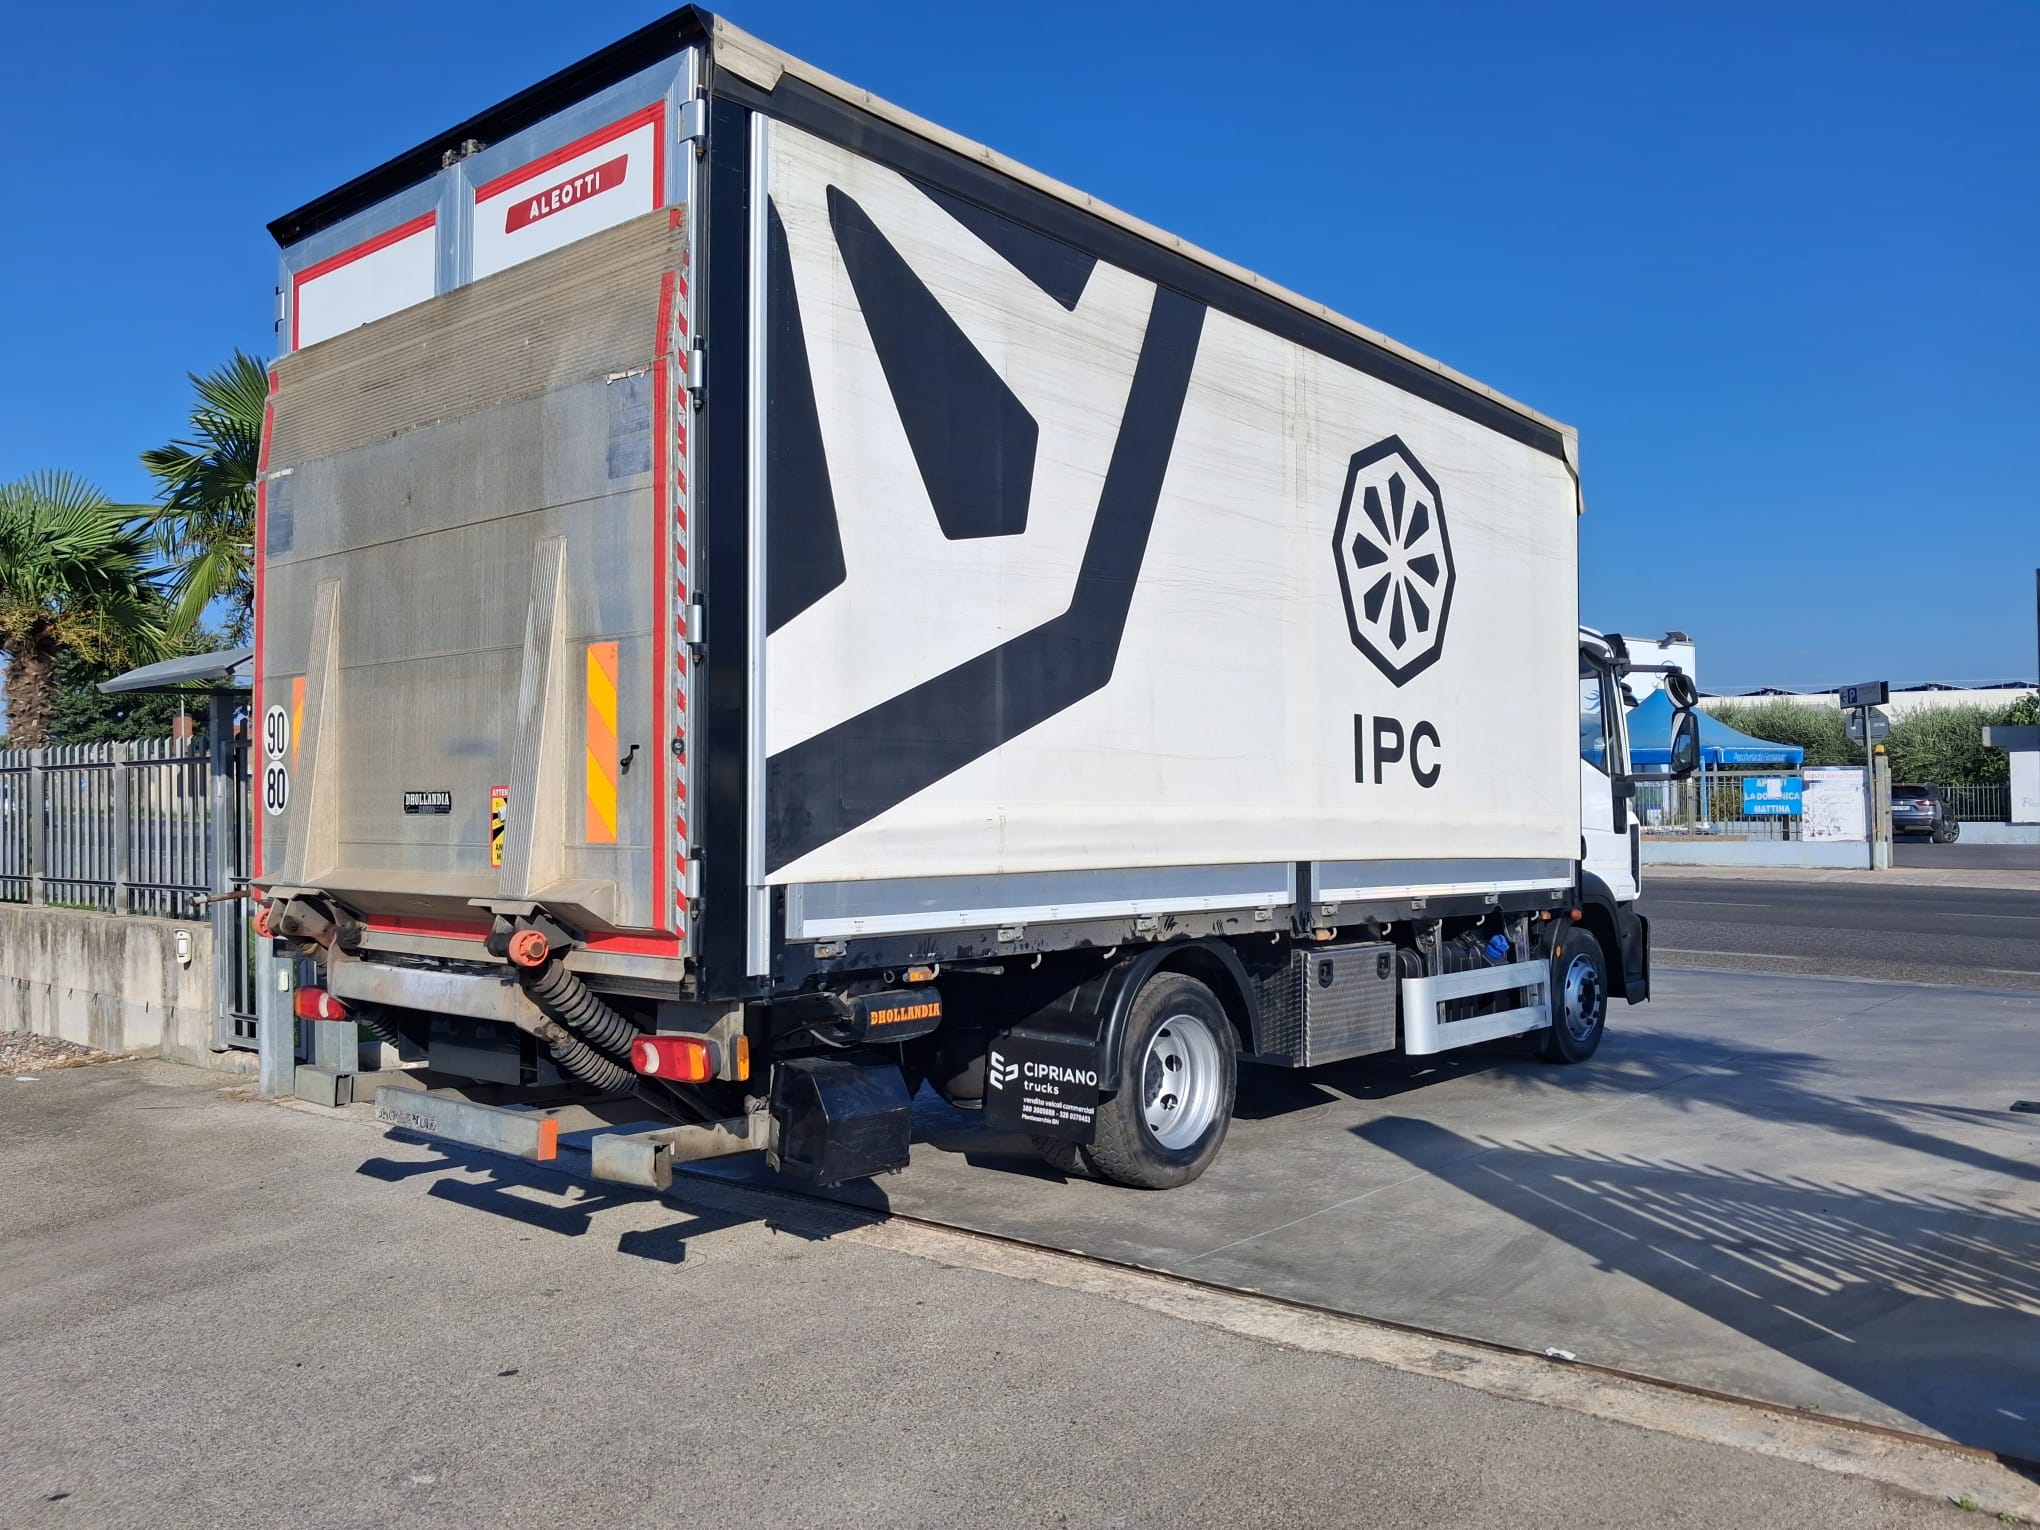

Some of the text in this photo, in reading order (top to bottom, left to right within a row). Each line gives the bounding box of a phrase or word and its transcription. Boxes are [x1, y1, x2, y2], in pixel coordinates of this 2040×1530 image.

[529, 171, 600, 219] ALEOTTI
[268, 711, 284, 754] 90
[1354, 713, 1441, 788] IPC
[267, 768, 285, 809] 80
[405, 793, 450, 805] DHOLLANDIA
[1754, 804, 1790, 813] MATTINA
[870, 1002, 941, 1025] DHOLLANDIA
[1023, 1062, 1098, 1086] CIPRIANO
[1023, 1080, 1060, 1095] trucks
